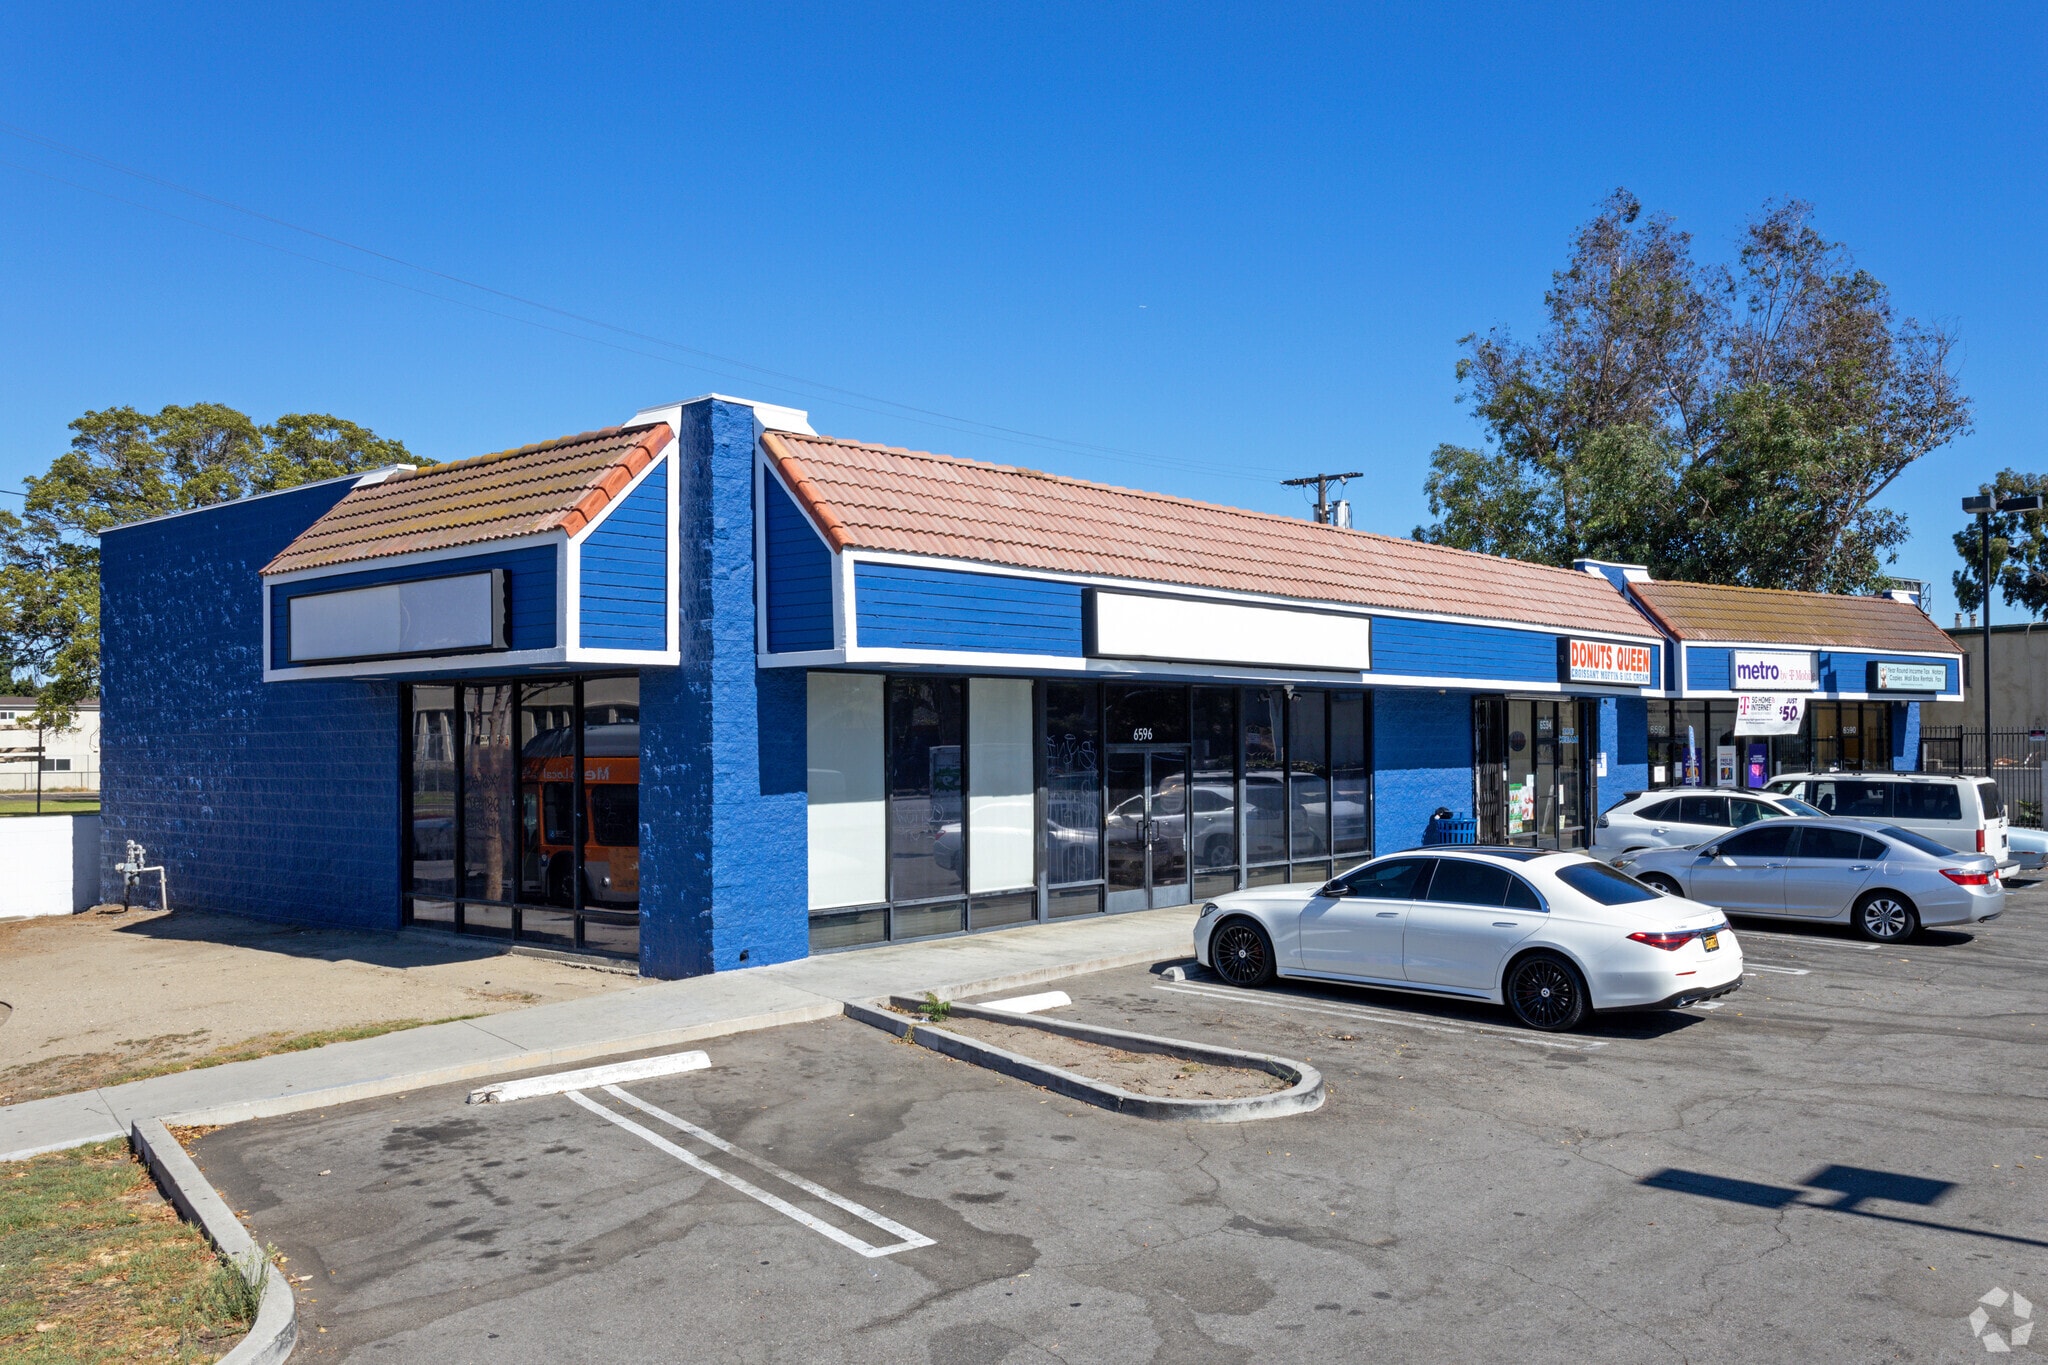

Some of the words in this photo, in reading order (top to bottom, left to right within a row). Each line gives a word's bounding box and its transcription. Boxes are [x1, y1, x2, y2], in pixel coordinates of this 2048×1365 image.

[1572, 642, 1612, 670] DONUTS
[1617, 646, 1649, 672] QUEEN
[1571, 668, 1599, 678] CROISSANT
[1600, 670, 1618, 680] MUFFIN
[1624, 672, 1632, 681] ICE
[1633, 673, 1648, 682] CREAM
[1737, 661, 1779, 680] metro
[1780, 670, 1787, 681] by
[1779, 705, 1798, 721] $50
[1133, 727, 1153, 741] 6596
[1650, 726, 1666, 734] 6592
